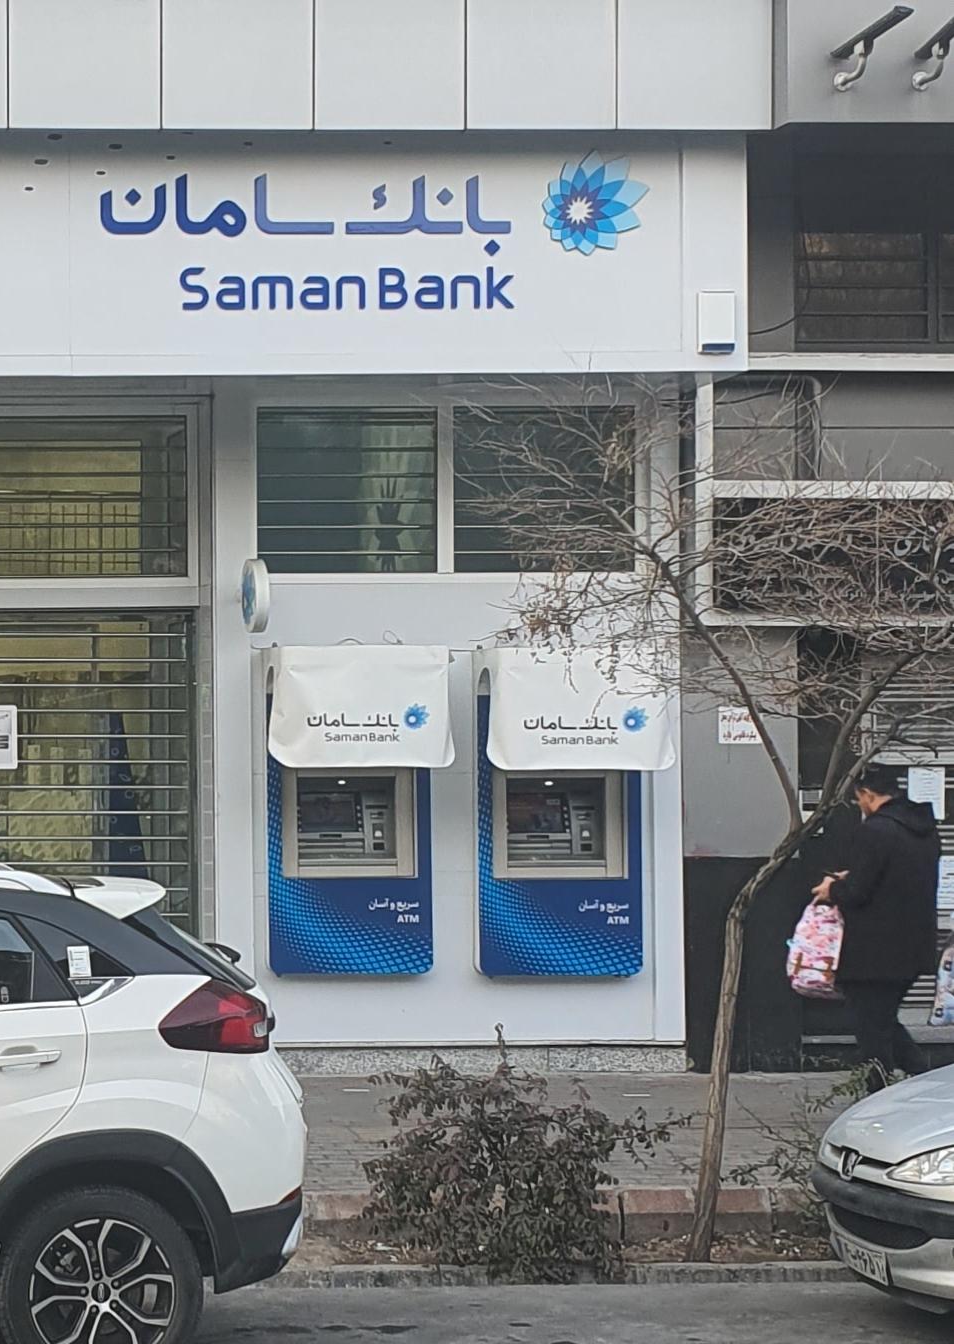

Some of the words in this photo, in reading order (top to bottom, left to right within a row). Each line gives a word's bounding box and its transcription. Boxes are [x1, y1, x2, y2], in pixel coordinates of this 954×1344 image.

[99, 173, 334, 237] سامان
[180, 267, 366, 311] Saman
[379, 266, 515, 311] Bank
[307, 713, 360, 727] سامان
[523, 716, 577, 730] سامان
[325, 732, 367, 742] Saman
[369, 732, 400, 742] Bank
[541, 735, 584, 745] Saman
[586, 735, 619, 745] Bank
[368, 898, 389, 911] آسان
[390, 902, 396, 911] و
[396, 901, 419, 912] سریع
[578, 899, 599, 912] آسان
[600, 903, 606, 912] و
[606, 903, 629, 914] سریع
[397, 914, 420, 923] ATM
[607, 916, 630, 925] ATM
